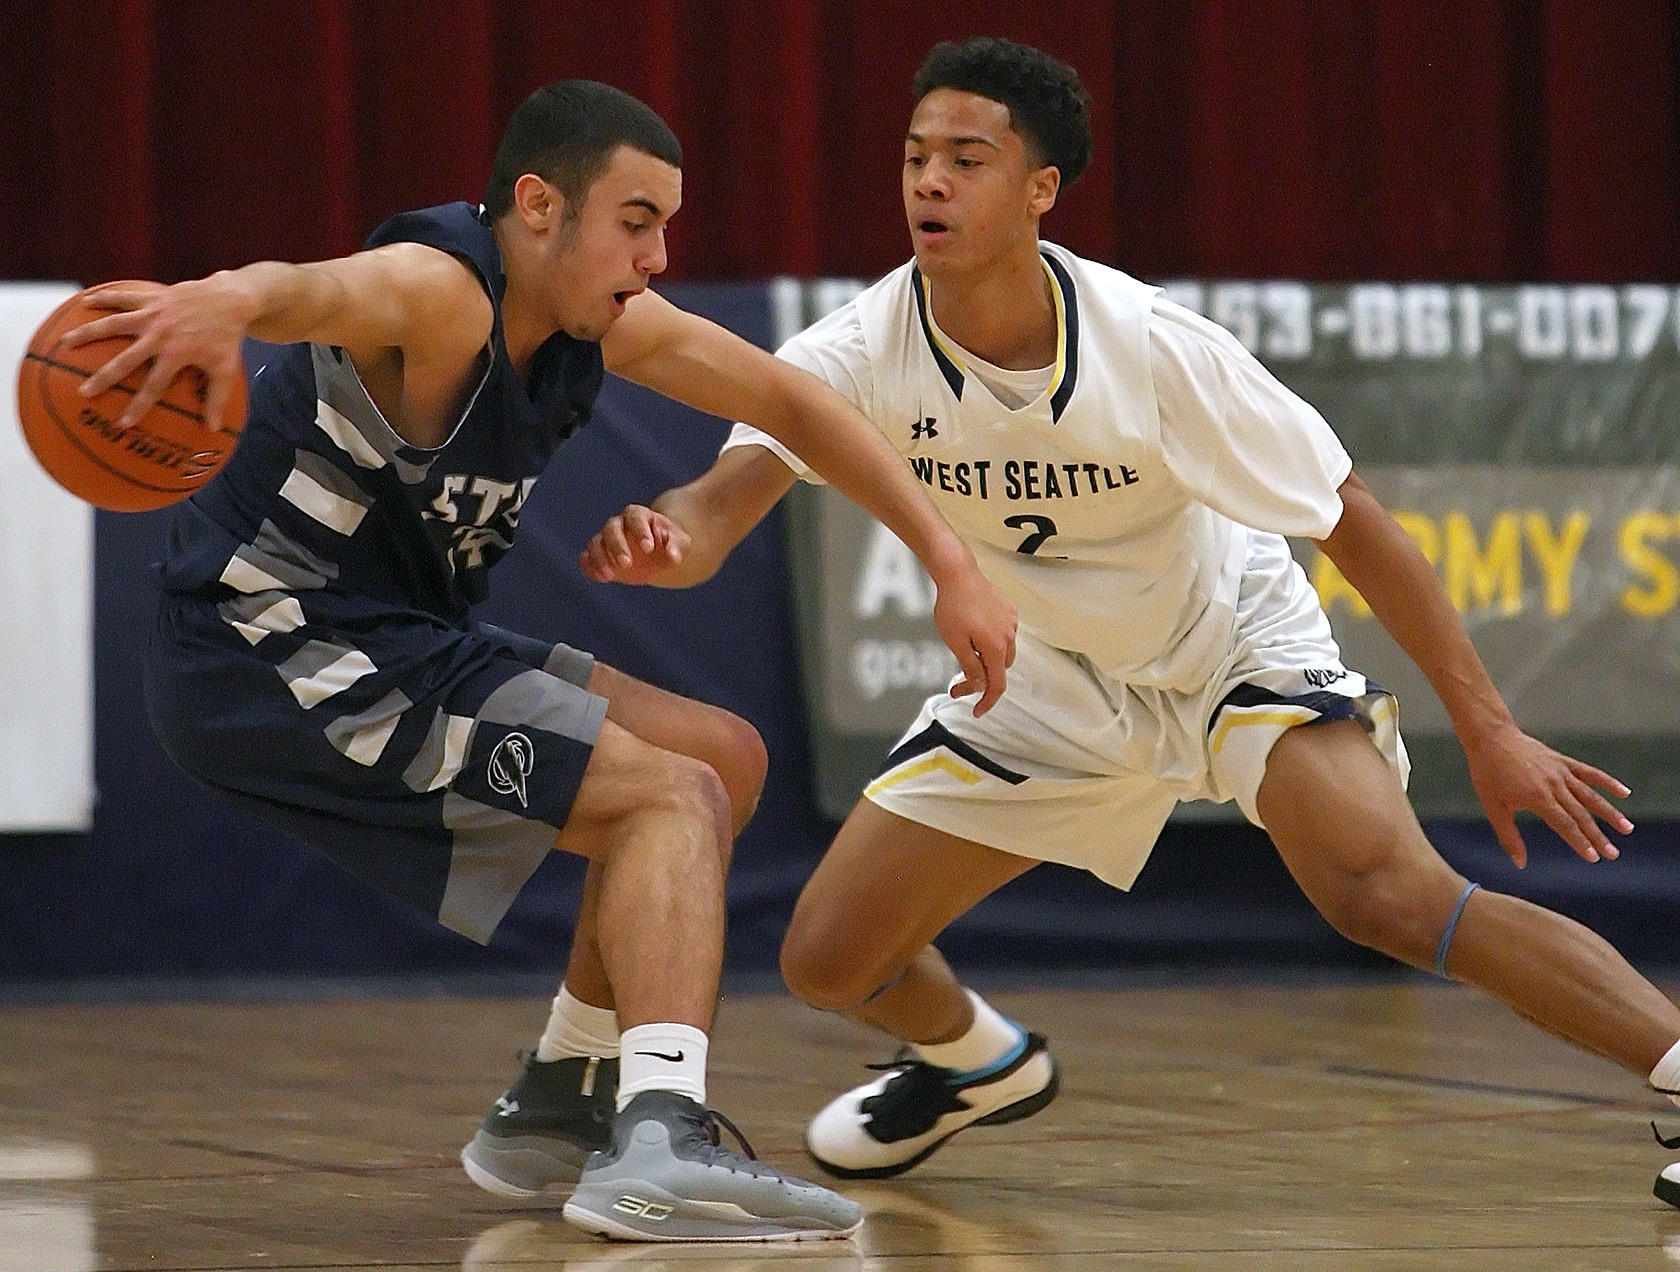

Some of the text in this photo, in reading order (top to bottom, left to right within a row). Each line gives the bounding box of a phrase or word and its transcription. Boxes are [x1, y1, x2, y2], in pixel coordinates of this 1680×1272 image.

[908, 456, 1140, 500] WEST SEATTLE
[1003, 514, 1069, 560] 2
[1618, 510, 1680, 616] S
